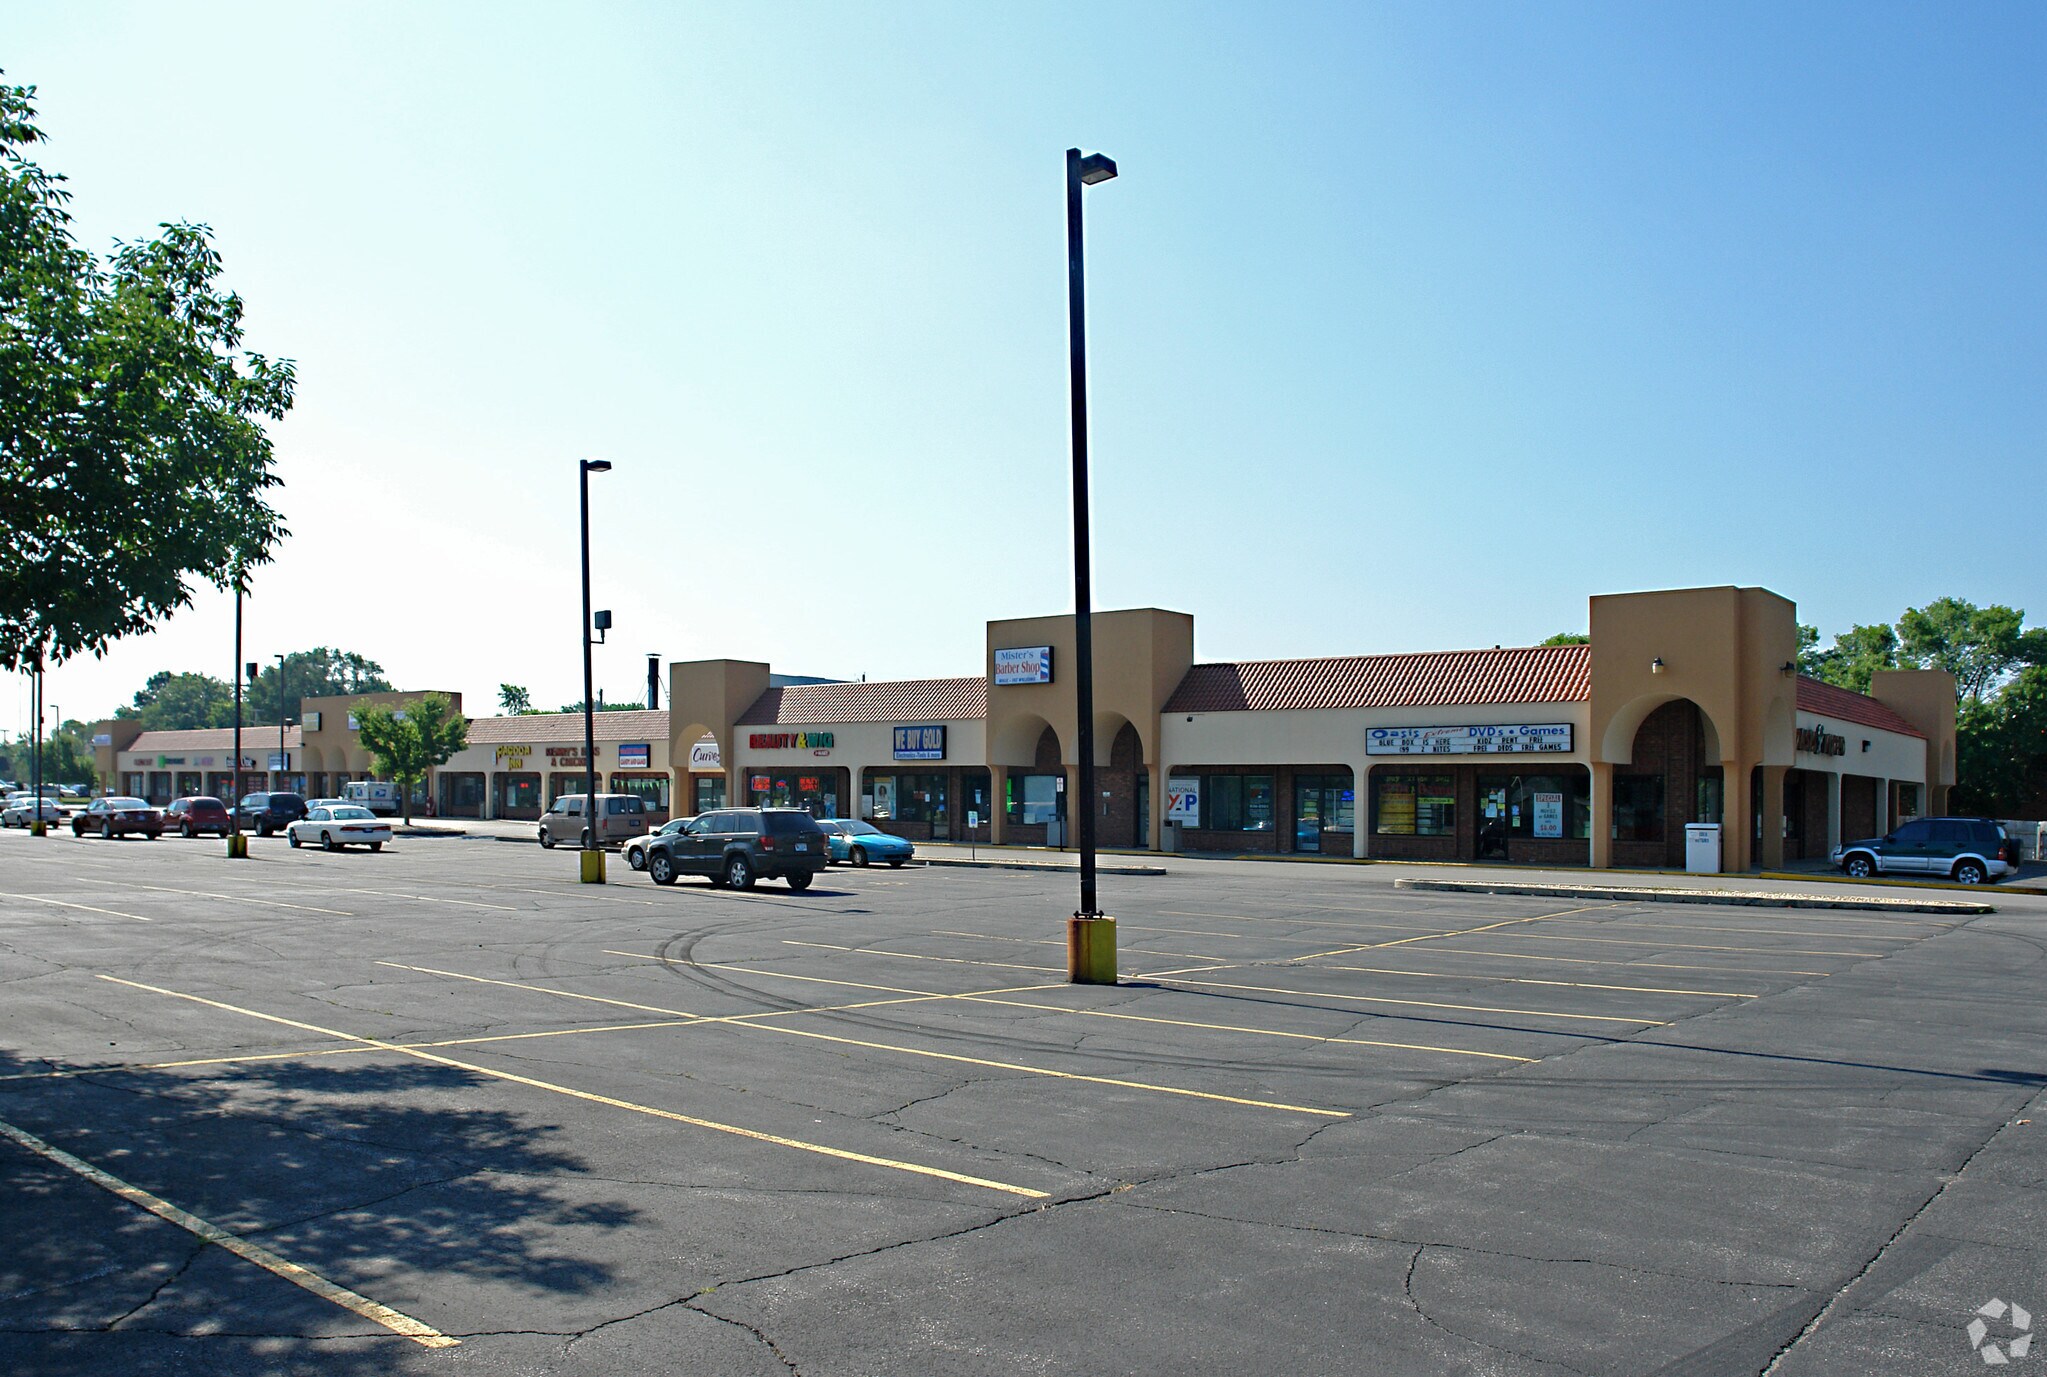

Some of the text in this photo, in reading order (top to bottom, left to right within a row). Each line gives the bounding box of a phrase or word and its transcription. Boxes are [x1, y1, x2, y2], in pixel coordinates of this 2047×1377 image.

[1000, 650, 1034, 660] Mister's
[995, 660, 1040, 675] Barber Shop
[895, 728, 942, 749] WE BUY GOLD
[1371, 725, 1565, 739] Oasis Extreme DVD's Games
[749, 733, 797, 749] BEAUTY
[807, 732, 835, 748] WIG
[1435, 738, 1450, 746] HERE
[1538, 743, 1562, 751] GAMES
[496, 745, 531, 758] PAGODA
[692, 748, 720, 763] Curves
[508, 757, 523, 770] INN
